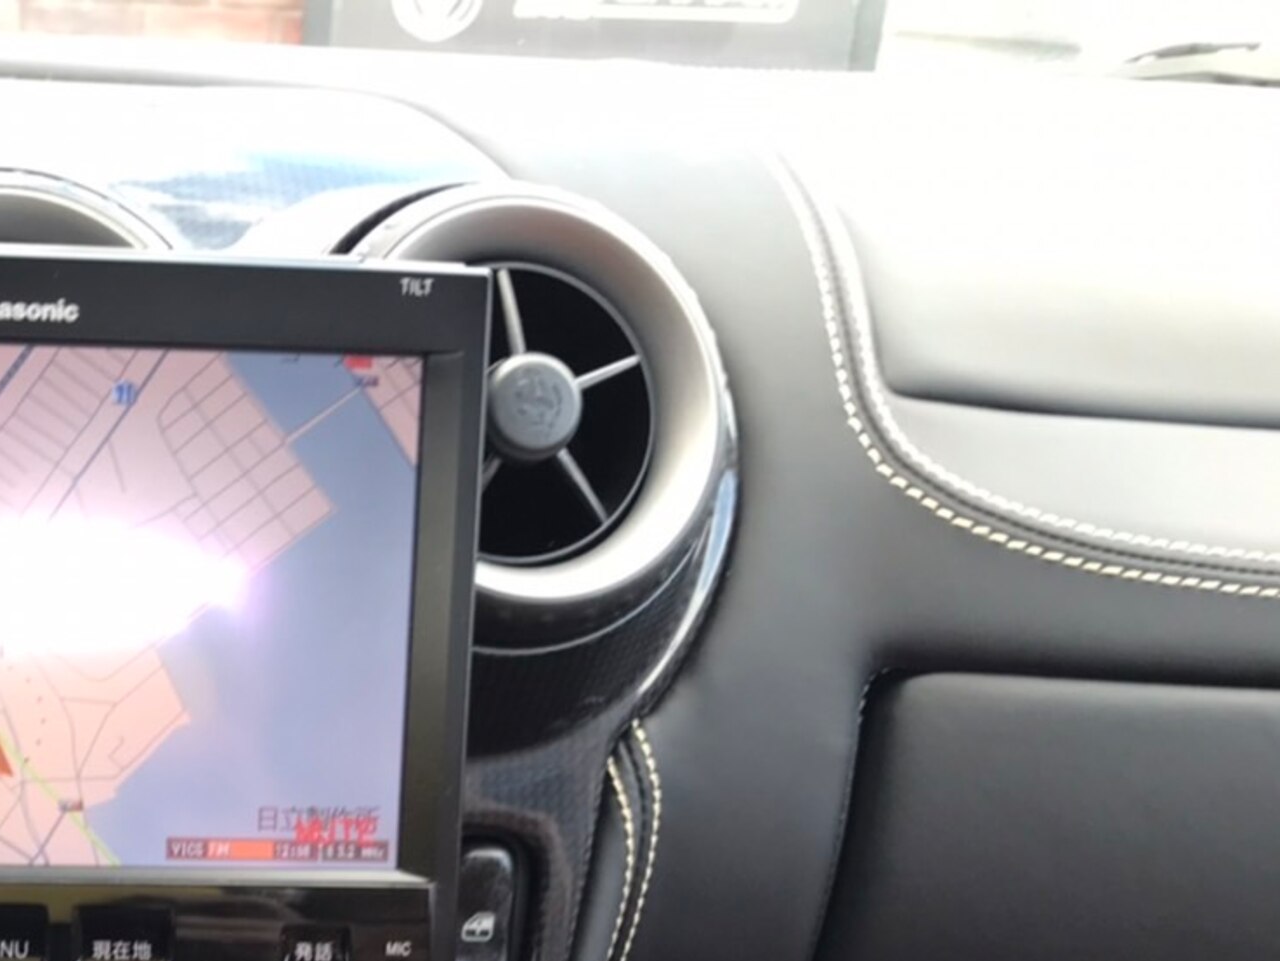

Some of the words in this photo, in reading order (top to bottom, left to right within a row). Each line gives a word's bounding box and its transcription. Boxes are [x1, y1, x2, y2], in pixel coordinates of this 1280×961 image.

[400, 278, 435, 296] TILT
[92, 939, 152, 961] 現在地
[385, 941, 412, 957] MIC
